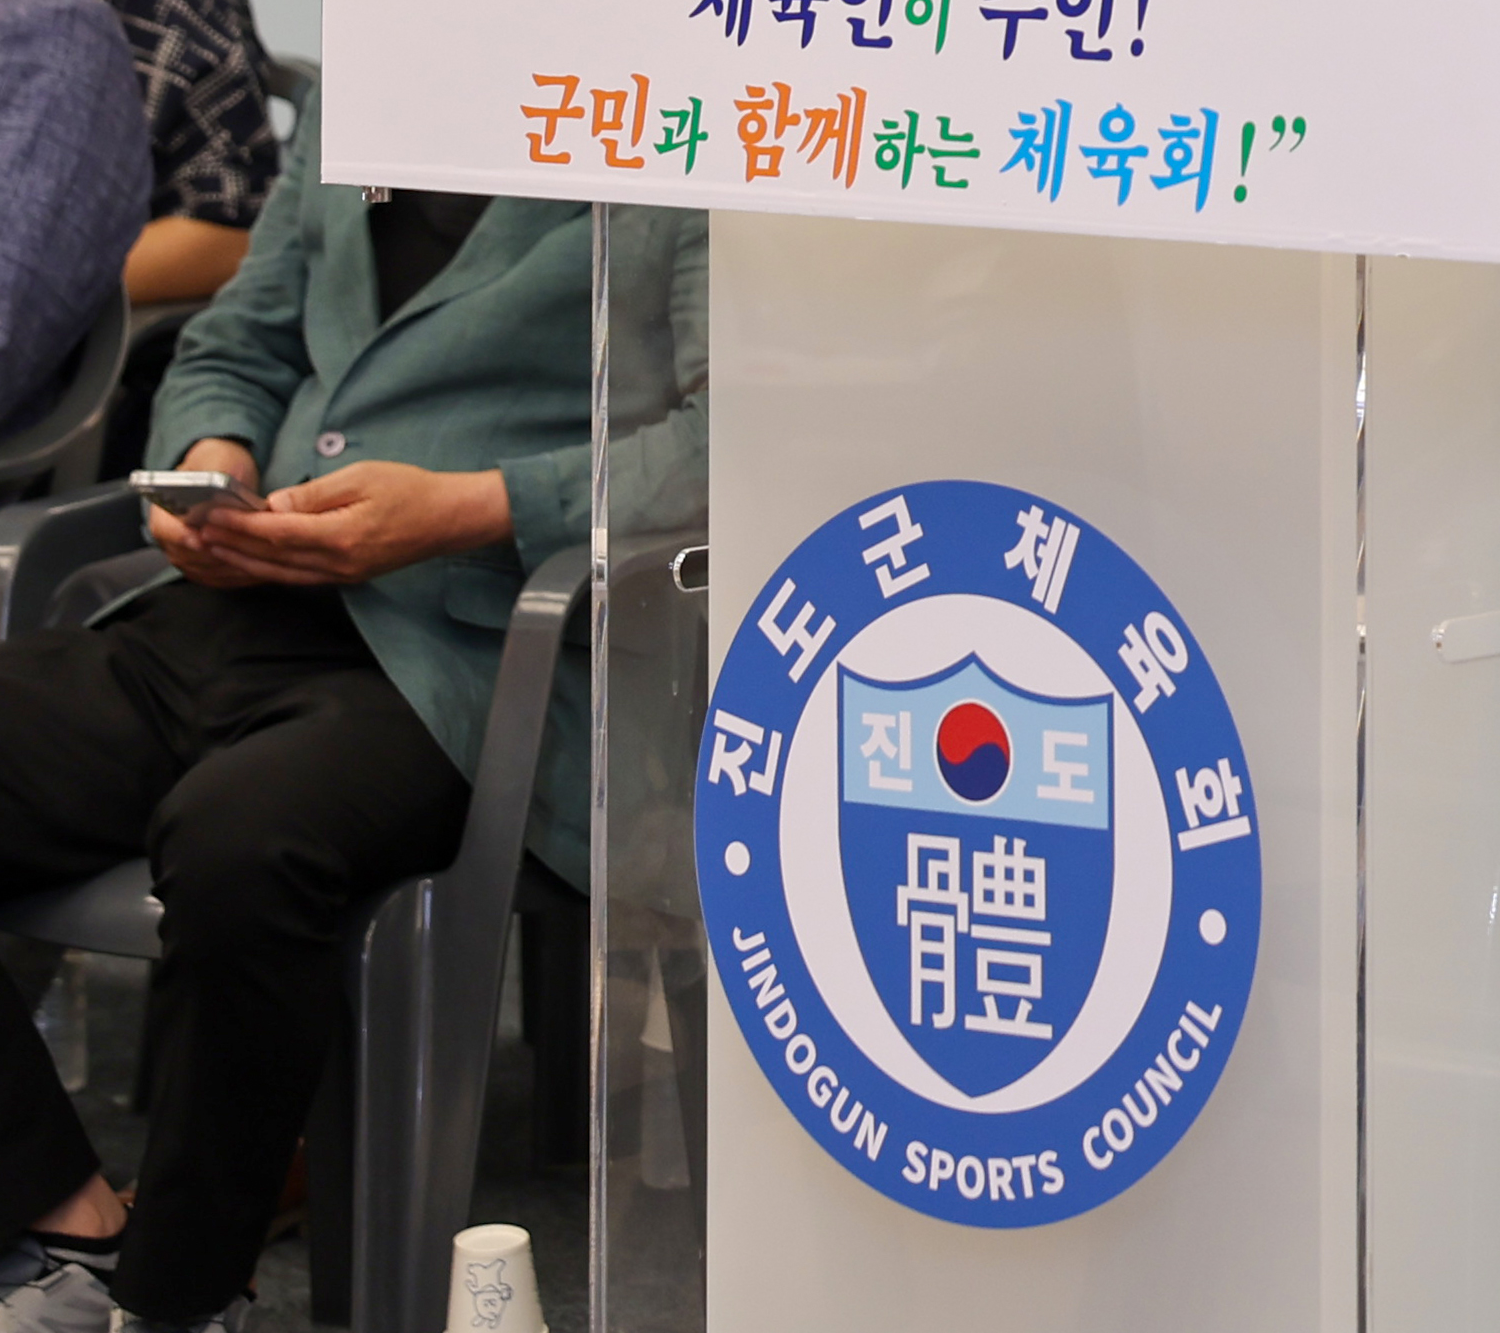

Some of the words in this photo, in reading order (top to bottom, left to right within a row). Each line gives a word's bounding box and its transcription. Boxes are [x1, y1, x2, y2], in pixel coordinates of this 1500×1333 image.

[520, 73, 709, 176] 군민과
[734, 81, 981, 190] 함께하는
[895, 832, 1054, 1041] 體
[731, 925, 889, 1162] JINDOGUN
[901, 1140, 1066, 1202] SPORTS
[1082, 999, 1224, 1172] COUNCIL
